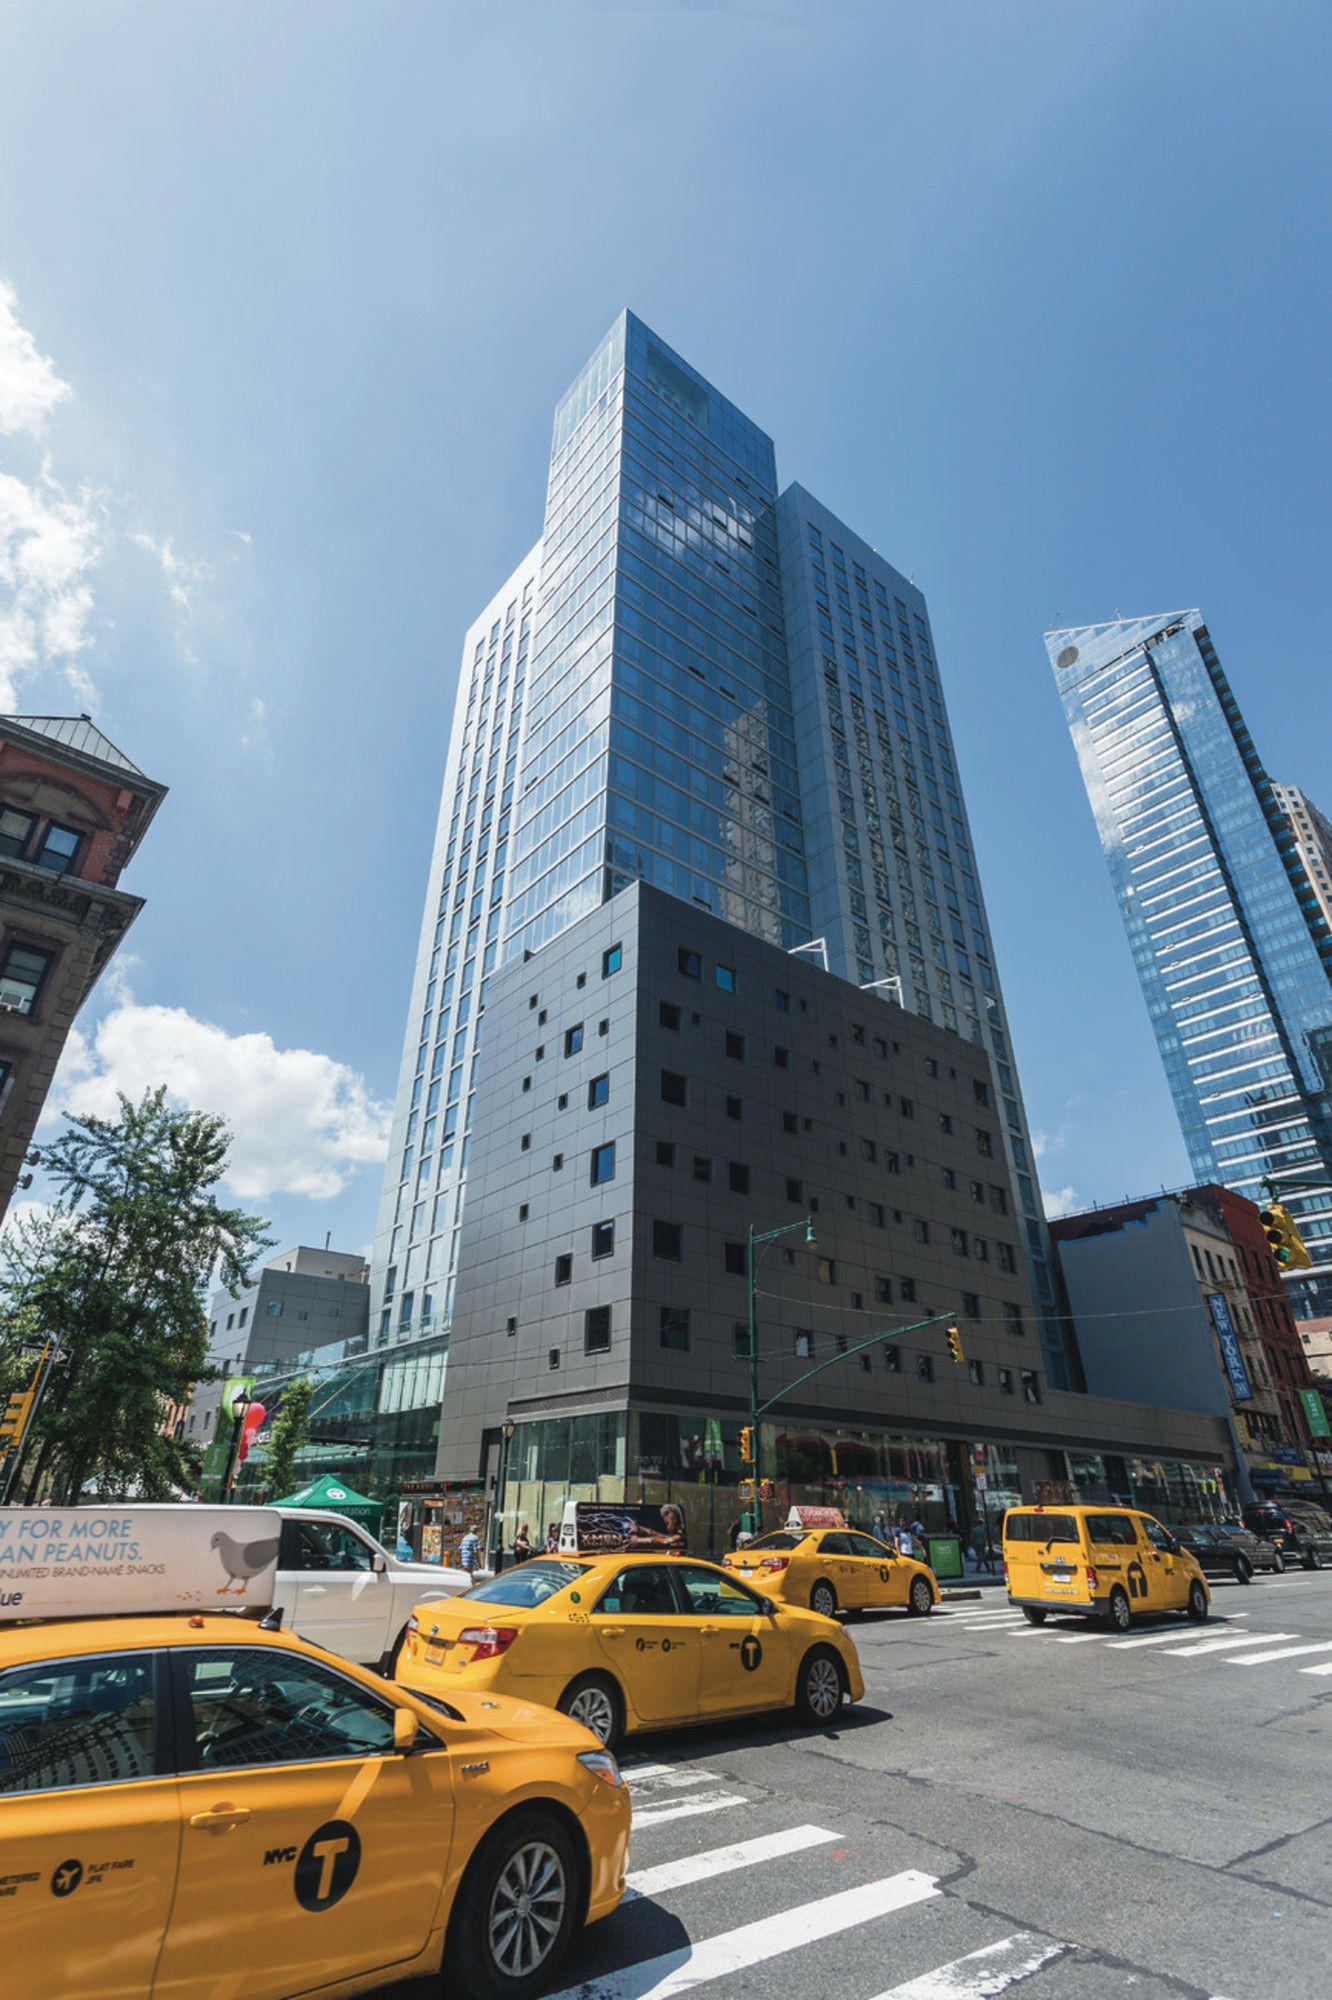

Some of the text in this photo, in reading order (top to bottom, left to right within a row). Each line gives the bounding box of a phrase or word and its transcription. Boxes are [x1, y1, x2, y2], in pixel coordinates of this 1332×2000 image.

[1212, 1297, 1229, 1330] NEW
[1222, 1334, 1243, 1380] YORK
[18, 1519, 62, 1539] FOR
[69, 1518, 133, 1538] MORE
[0, 1541, 143, 1563] AN PEANUTS.
[52, 1565, 124, 1577] BRAND-NAME
[126, 1563, 165, 1575] SNACKS.
[263, 1837, 350, 1900] NYC T
